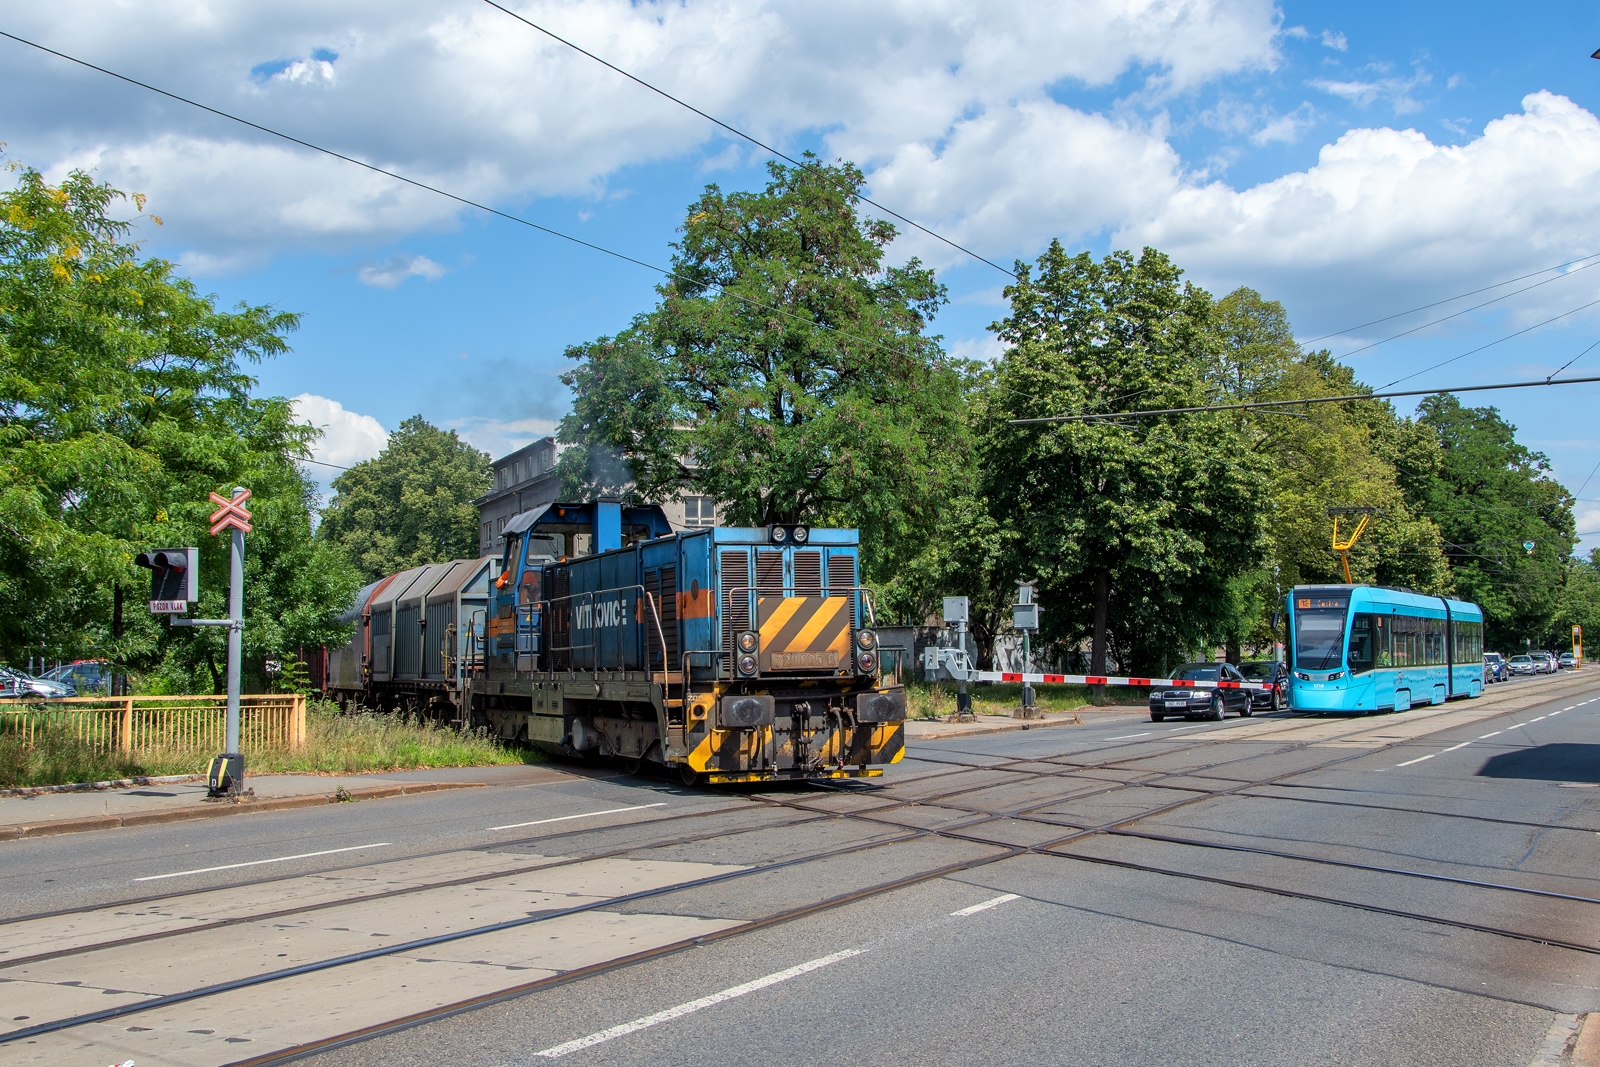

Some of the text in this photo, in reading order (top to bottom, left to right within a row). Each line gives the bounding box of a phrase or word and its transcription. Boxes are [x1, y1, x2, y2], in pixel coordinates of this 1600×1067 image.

[153, 602, 183, 611] POZOR VLAK
[211, 778, 217, 787] D
